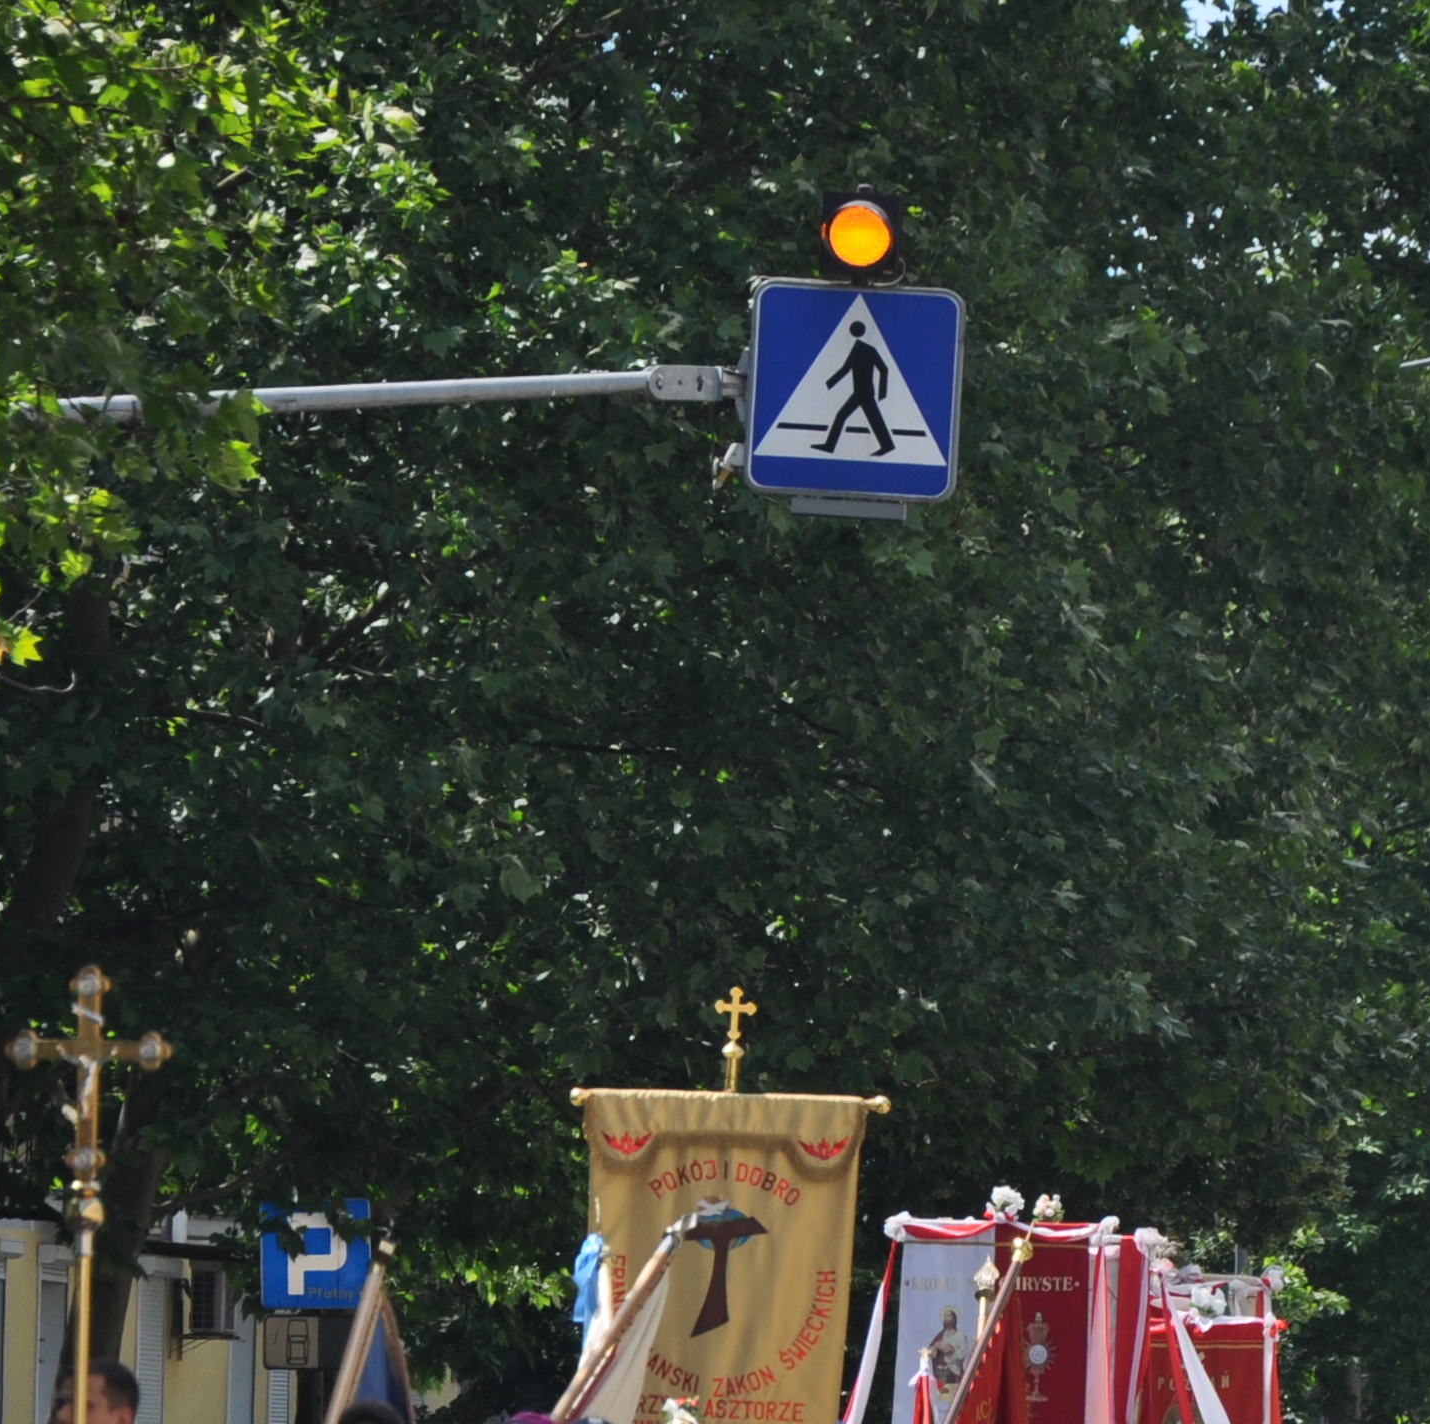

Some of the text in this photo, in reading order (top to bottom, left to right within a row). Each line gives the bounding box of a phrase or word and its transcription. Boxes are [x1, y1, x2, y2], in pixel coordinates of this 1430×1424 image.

[649, 1159, 800, 1206] POKÓJ I DOBRO
[712, 1366, 776, 1398] ZAKON
[778, 1270, 836, 1371] ŚWIECKICH
[1157, 1371, 1230, 1391] POZŃ
[703, 1399, 805, 1423] ASZTORZE
